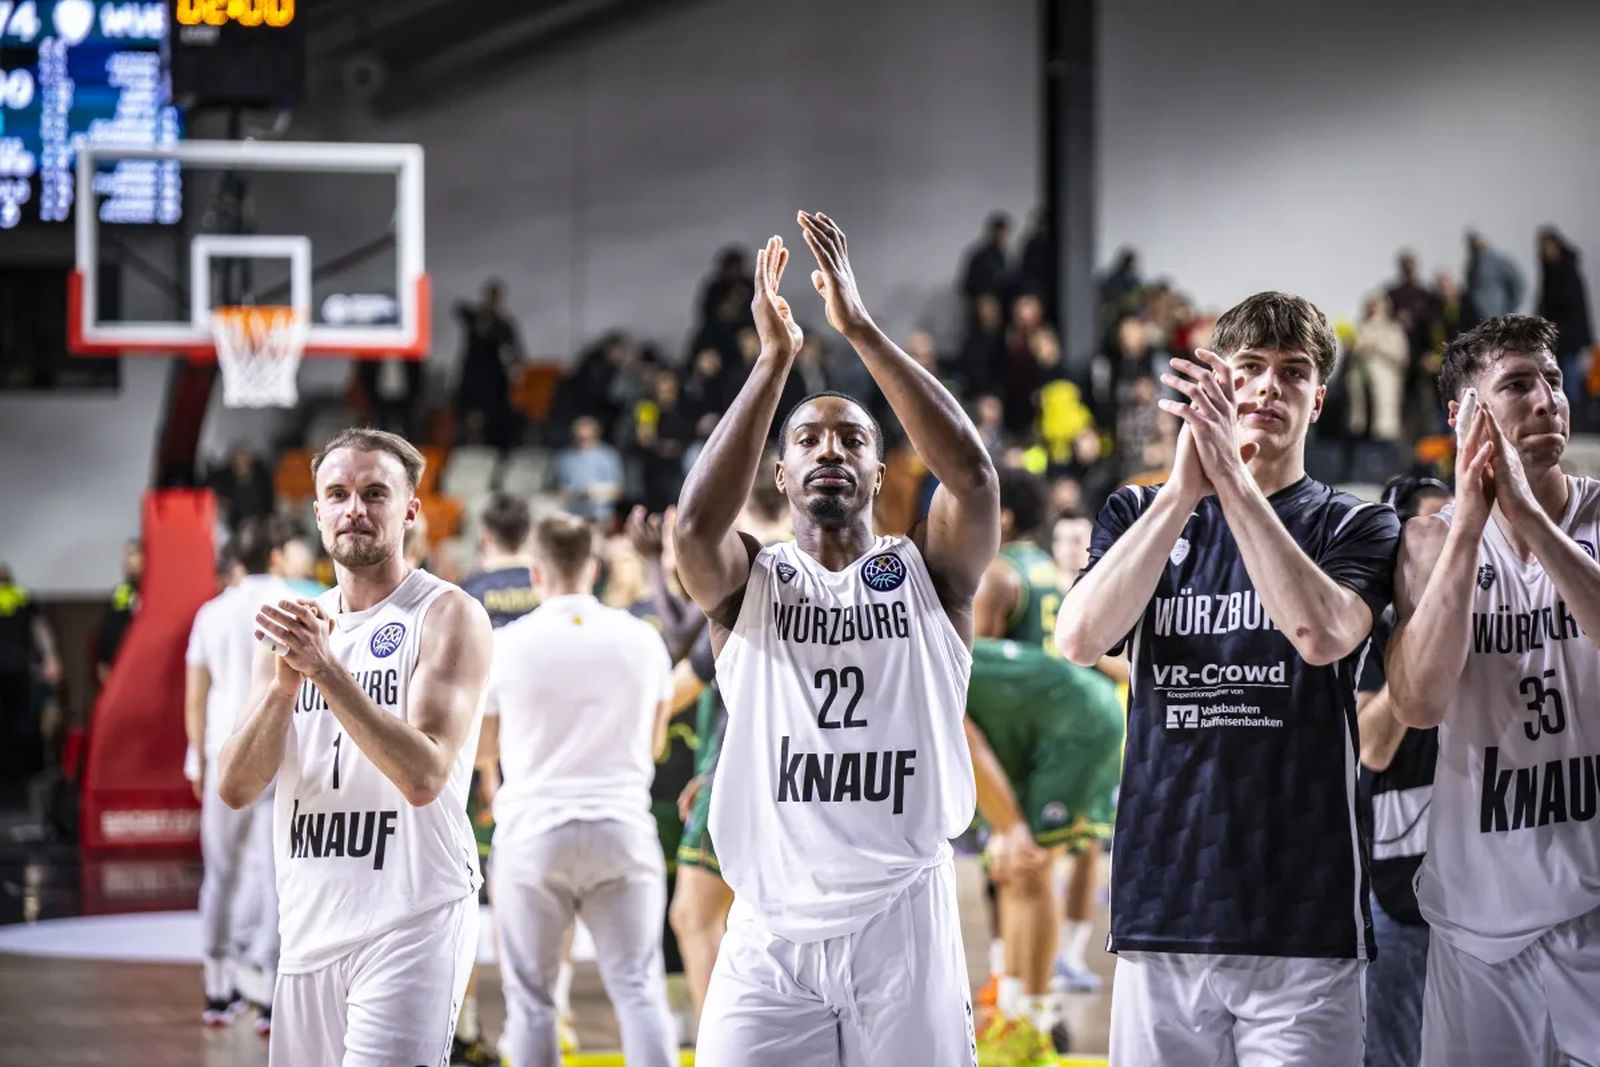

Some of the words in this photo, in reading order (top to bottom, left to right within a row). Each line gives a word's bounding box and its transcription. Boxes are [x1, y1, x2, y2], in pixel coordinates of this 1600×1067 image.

[774, 598, 909, 645] WÜRZBURG
[1155, 588, 1281, 637] WÜRZBU
[814, 666, 867, 729] 22
[1152, 661, 1285, 685] VR-Crowd
[1519, 669, 1566, 741] 35
[332, 732, 342, 789] 1
[1480, 746, 1600, 834] KNAU
